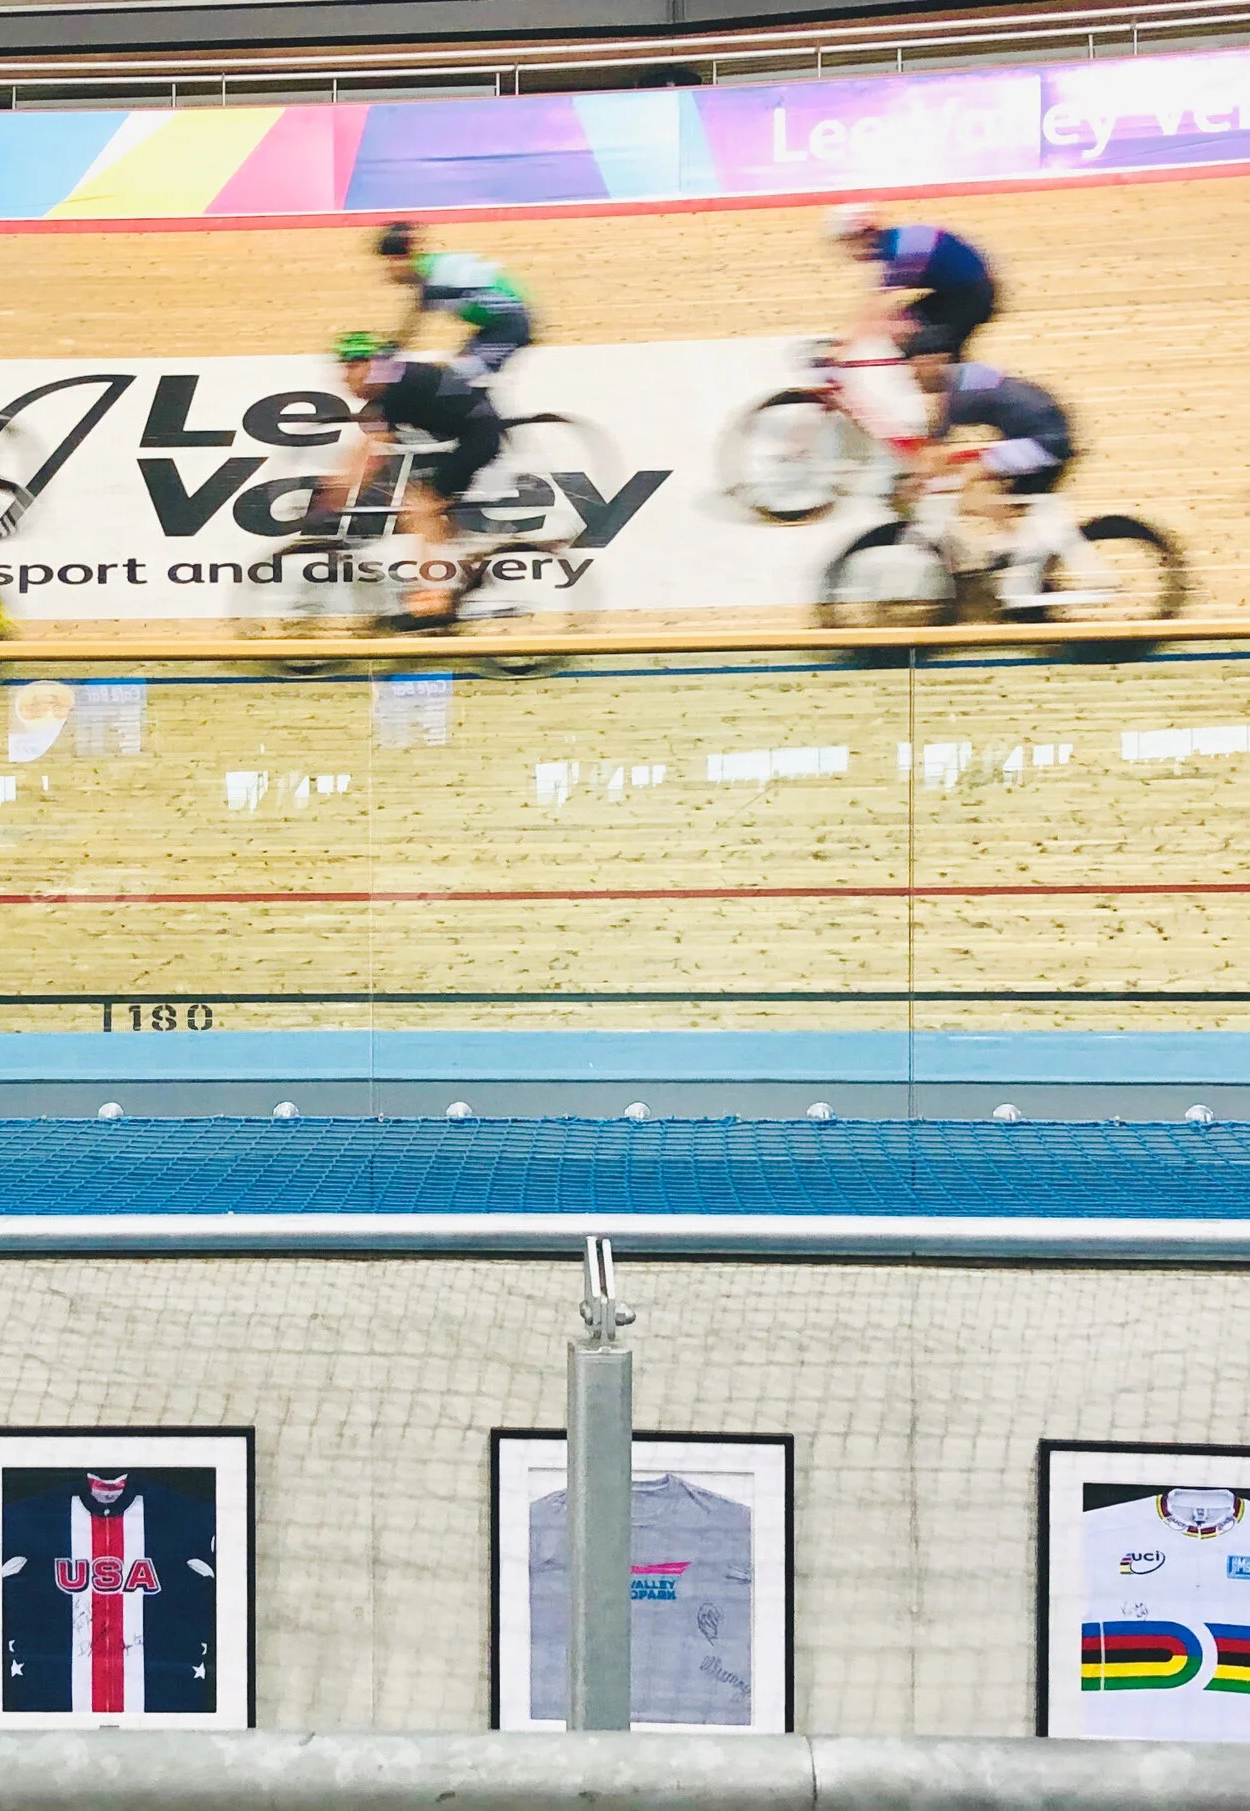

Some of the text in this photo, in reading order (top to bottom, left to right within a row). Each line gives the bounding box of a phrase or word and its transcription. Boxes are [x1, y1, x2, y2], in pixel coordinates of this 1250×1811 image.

[139, 374, 400, 448] Le
[167, 553, 283, 583] and
[302, 551, 595, 589] discovery
[128, 1004, 213, 1031] 180
[54, 1556, 162, 1595] USA
